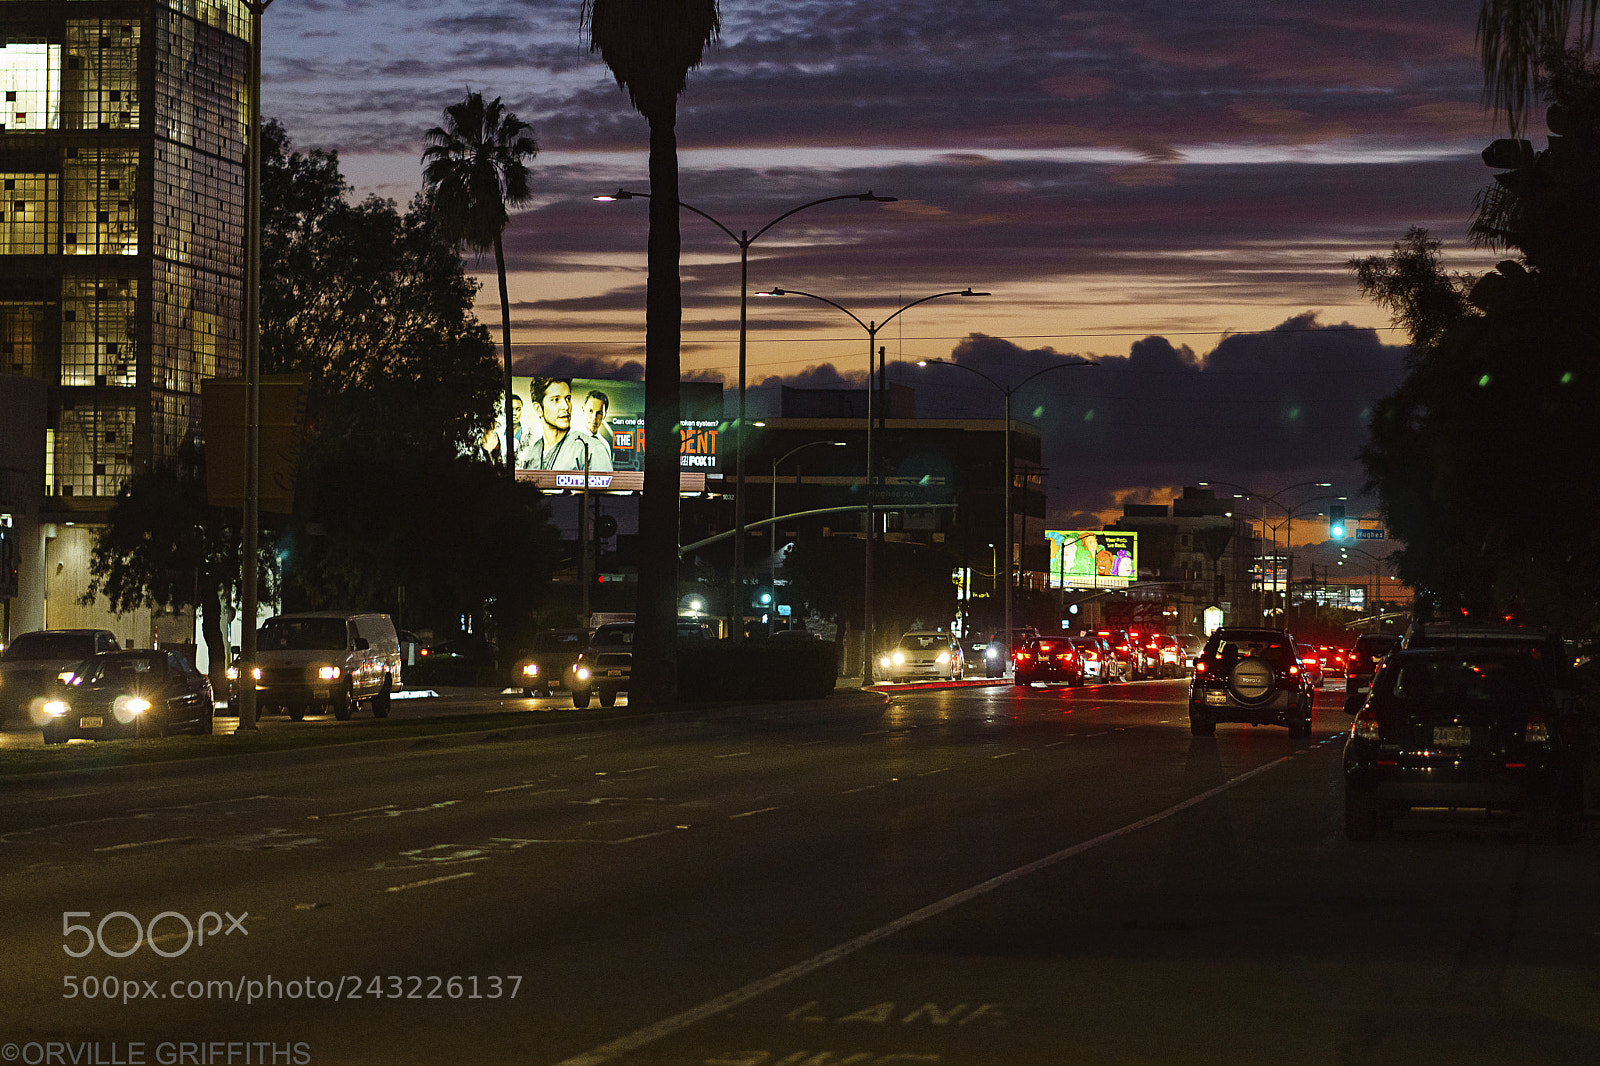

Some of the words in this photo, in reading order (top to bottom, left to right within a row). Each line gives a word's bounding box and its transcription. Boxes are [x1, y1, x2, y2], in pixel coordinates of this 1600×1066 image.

[612, 418, 625, 426] Can
[637, 418, 645, 426] do
[680, 419, 695, 427] roken
[696, 420, 719, 428] system?
[615, 434, 631, 446] THE
